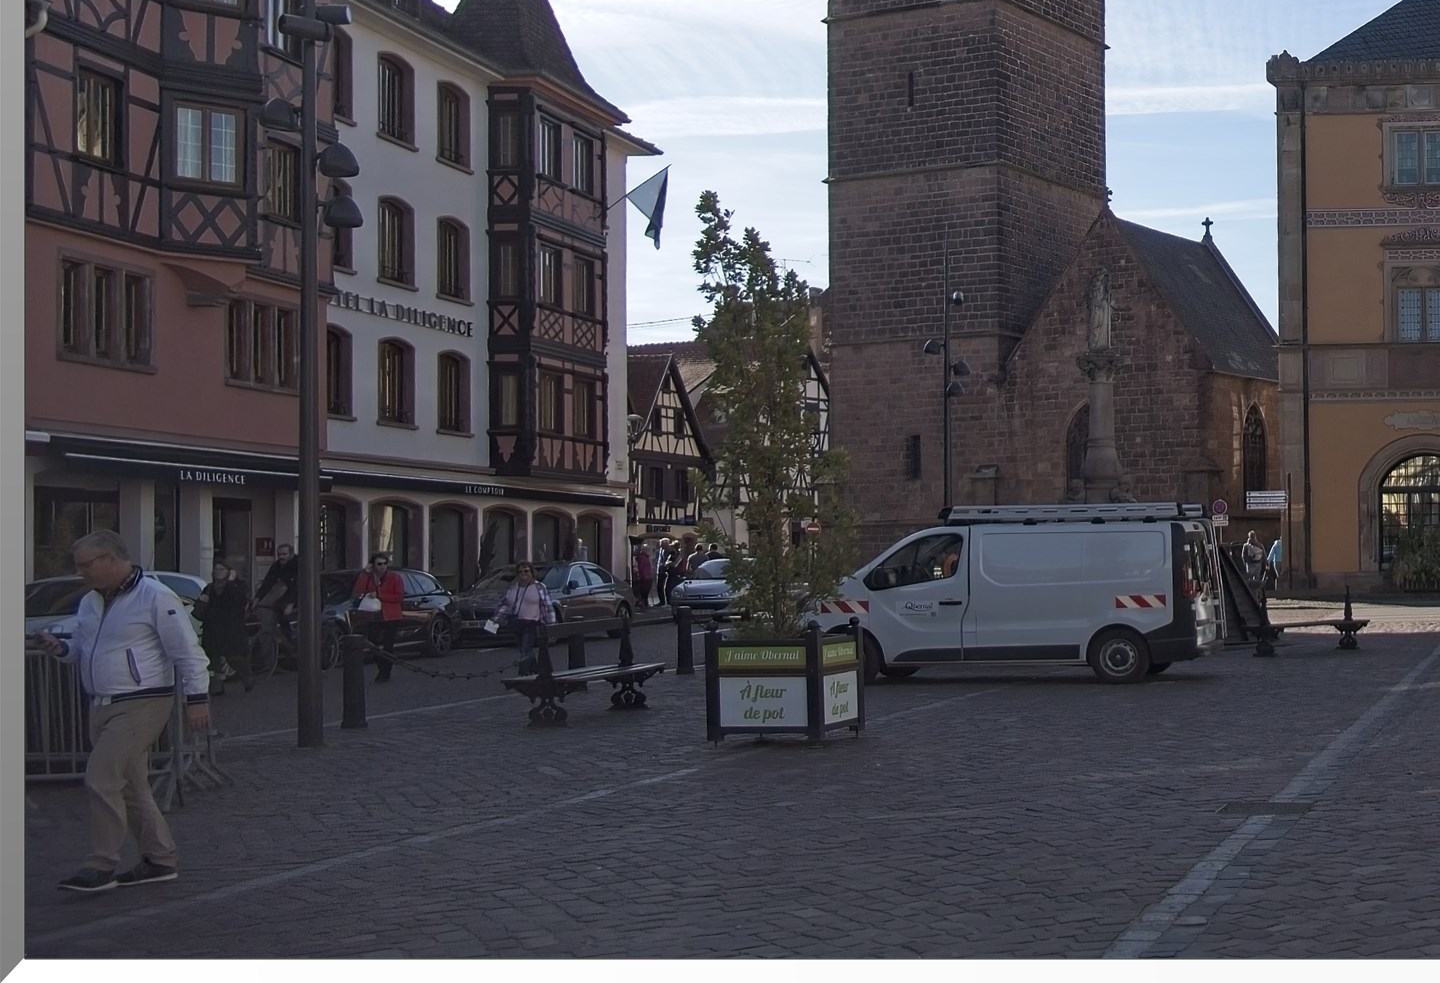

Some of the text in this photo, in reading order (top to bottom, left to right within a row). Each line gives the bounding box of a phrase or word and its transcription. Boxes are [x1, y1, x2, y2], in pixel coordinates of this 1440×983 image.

[371, 298, 389, 318] LA
[397, 304, 474, 338] DILIGENCE
[180, 470, 246, 485] LA DILIGENCE
[465, 486, 505, 496] LE COMPTOIR
[725, 650, 800, 663] J'aime Obernai
[740, 681, 787, 703] À fleur
[744, 707, 786, 724] de pot
